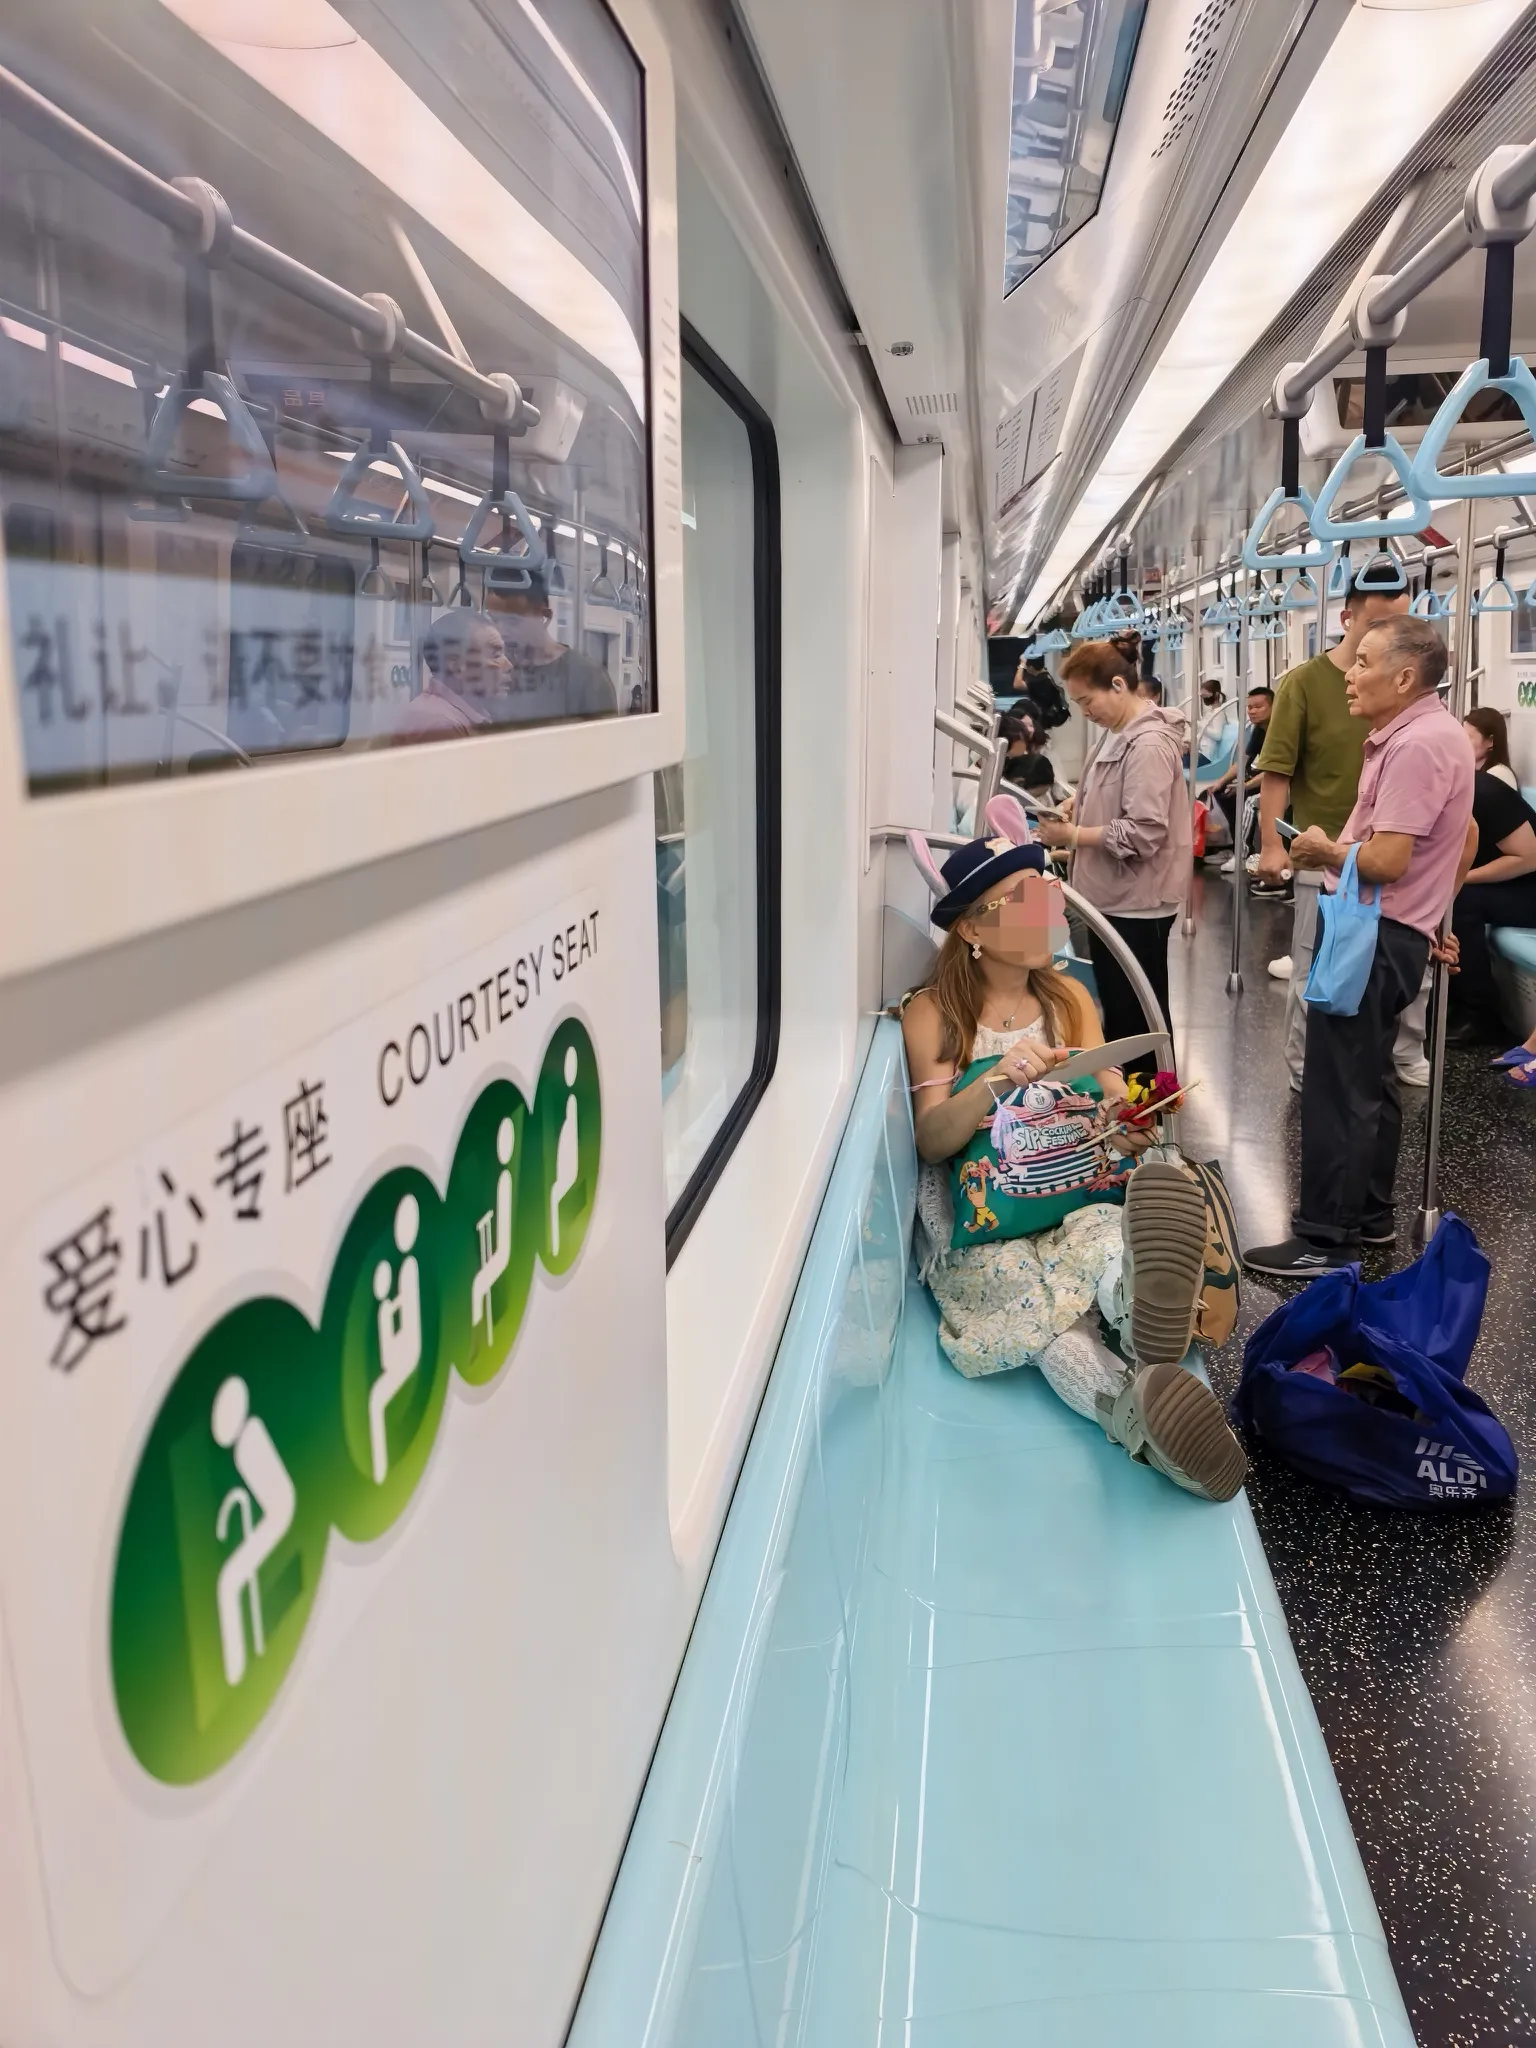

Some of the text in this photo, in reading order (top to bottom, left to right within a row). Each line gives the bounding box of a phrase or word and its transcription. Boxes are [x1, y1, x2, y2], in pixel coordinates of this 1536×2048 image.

[378, 910, 600, 1107] COURTESY SEAT
[1012, 1127, 1040, 1151] SIP
[1040, 1129, 1089, 1148] FESTIVAL
[42, 1078, 332, 1373] 爱心专座
[1416, 1459, 1488, 1489] ALDI
[1428, 1484, 1478, 1499] 奥乐齐
